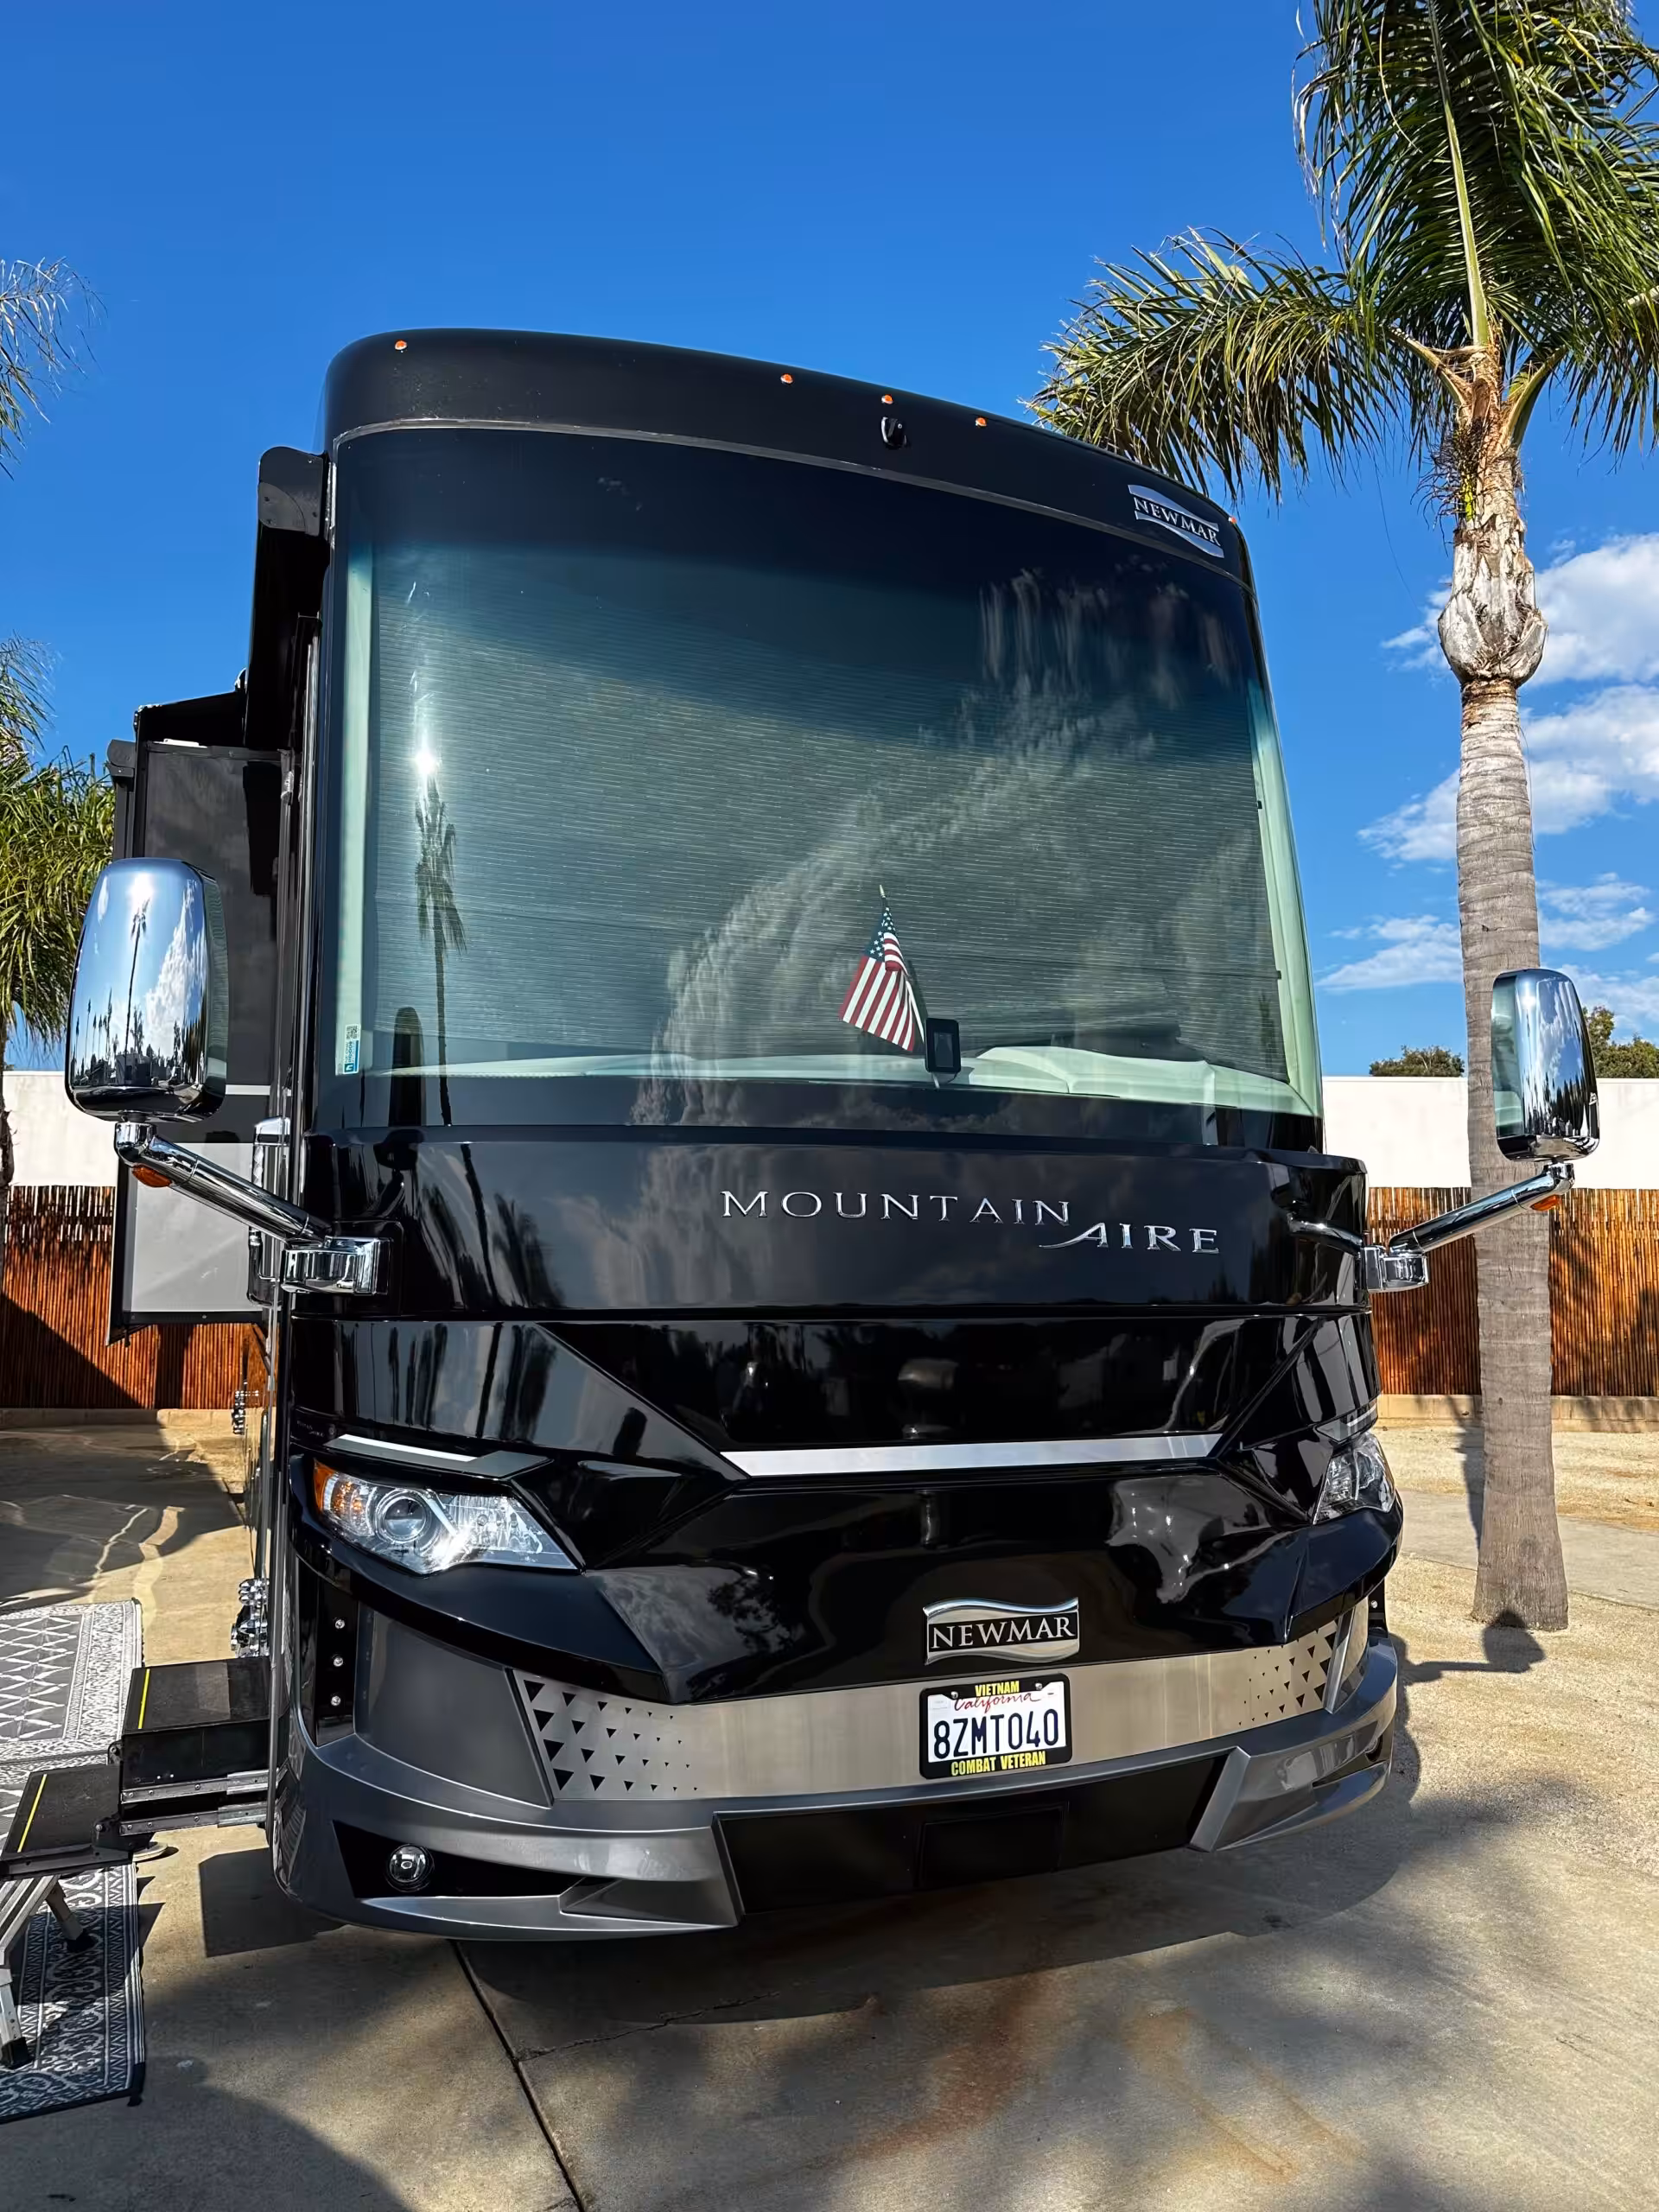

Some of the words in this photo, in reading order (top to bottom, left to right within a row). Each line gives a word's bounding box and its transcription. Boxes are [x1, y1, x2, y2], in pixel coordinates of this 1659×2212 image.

[1133, 496, 1221, 547] NEWMAR
[720, 1190, 1071, 1227] MOUNTAIN
[1038, 1222, 1220, 1254] AIRE
[930, 1616, 1076, 1649] NEWMAR
[954, 1691, 1042, 1714] California
[975, 1681, 1020, 1697] VIETNAM
[933, 1708, 1059, 1760] 8ZMT040
[951, 1757, 996, 1777] COMBAT
[1001, 1751, 1046, 1770] VETERAN
